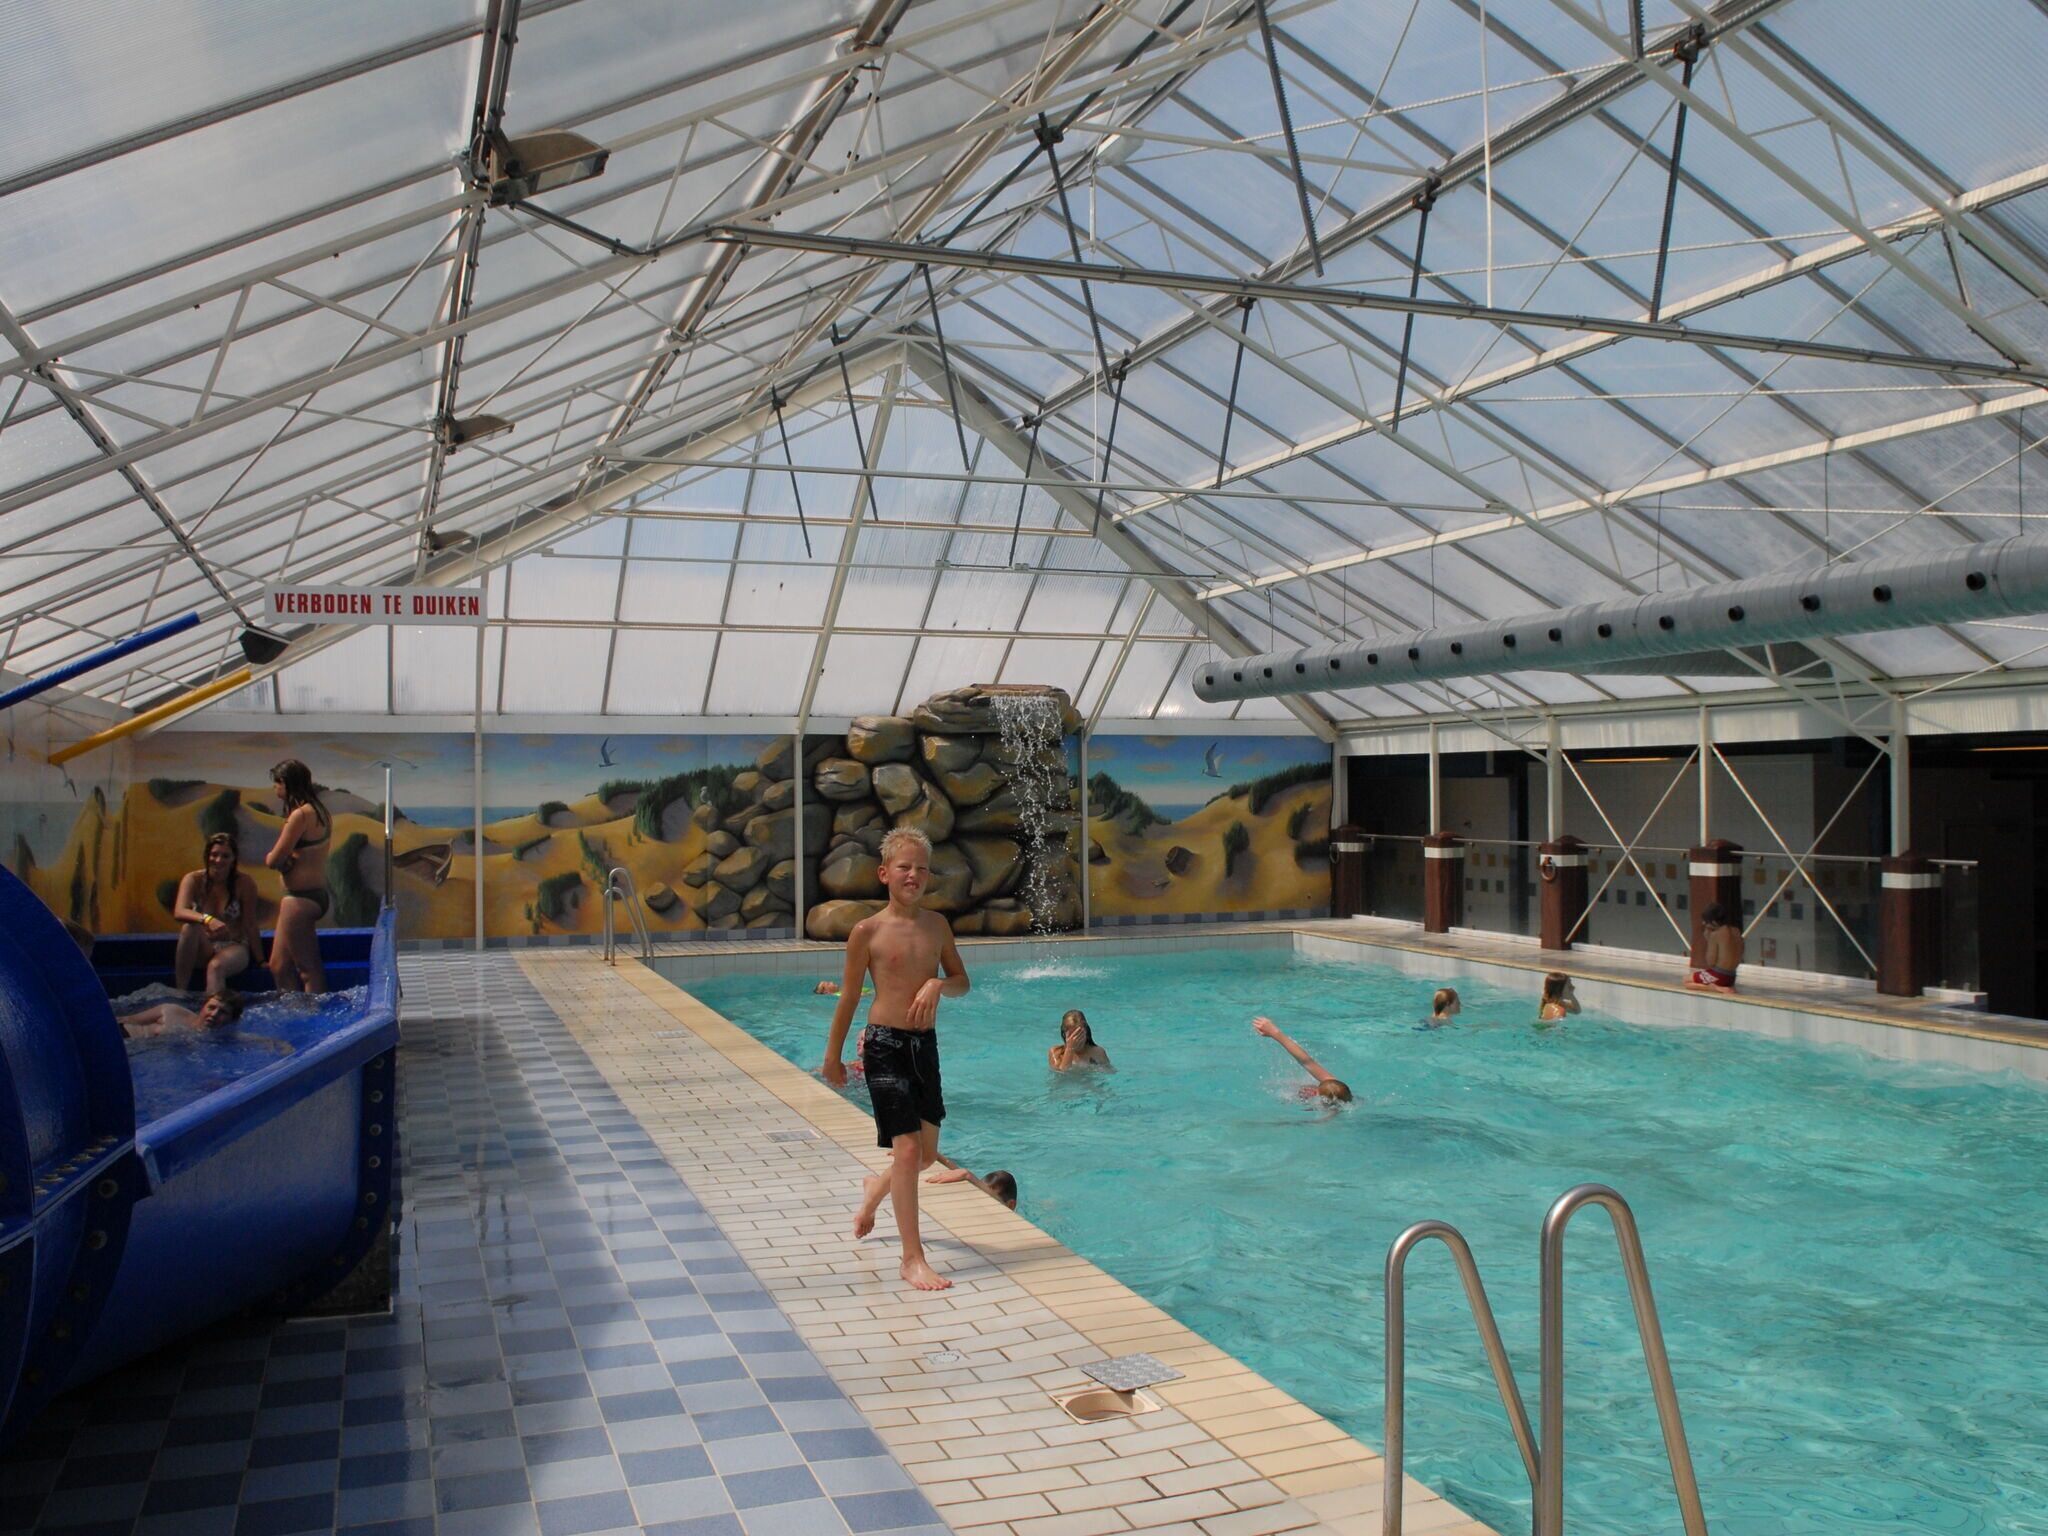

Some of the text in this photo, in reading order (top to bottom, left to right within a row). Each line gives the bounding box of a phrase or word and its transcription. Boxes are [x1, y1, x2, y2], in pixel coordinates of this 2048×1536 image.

[274, 592, 479, 616] VERBODEN TE DUIKEN
